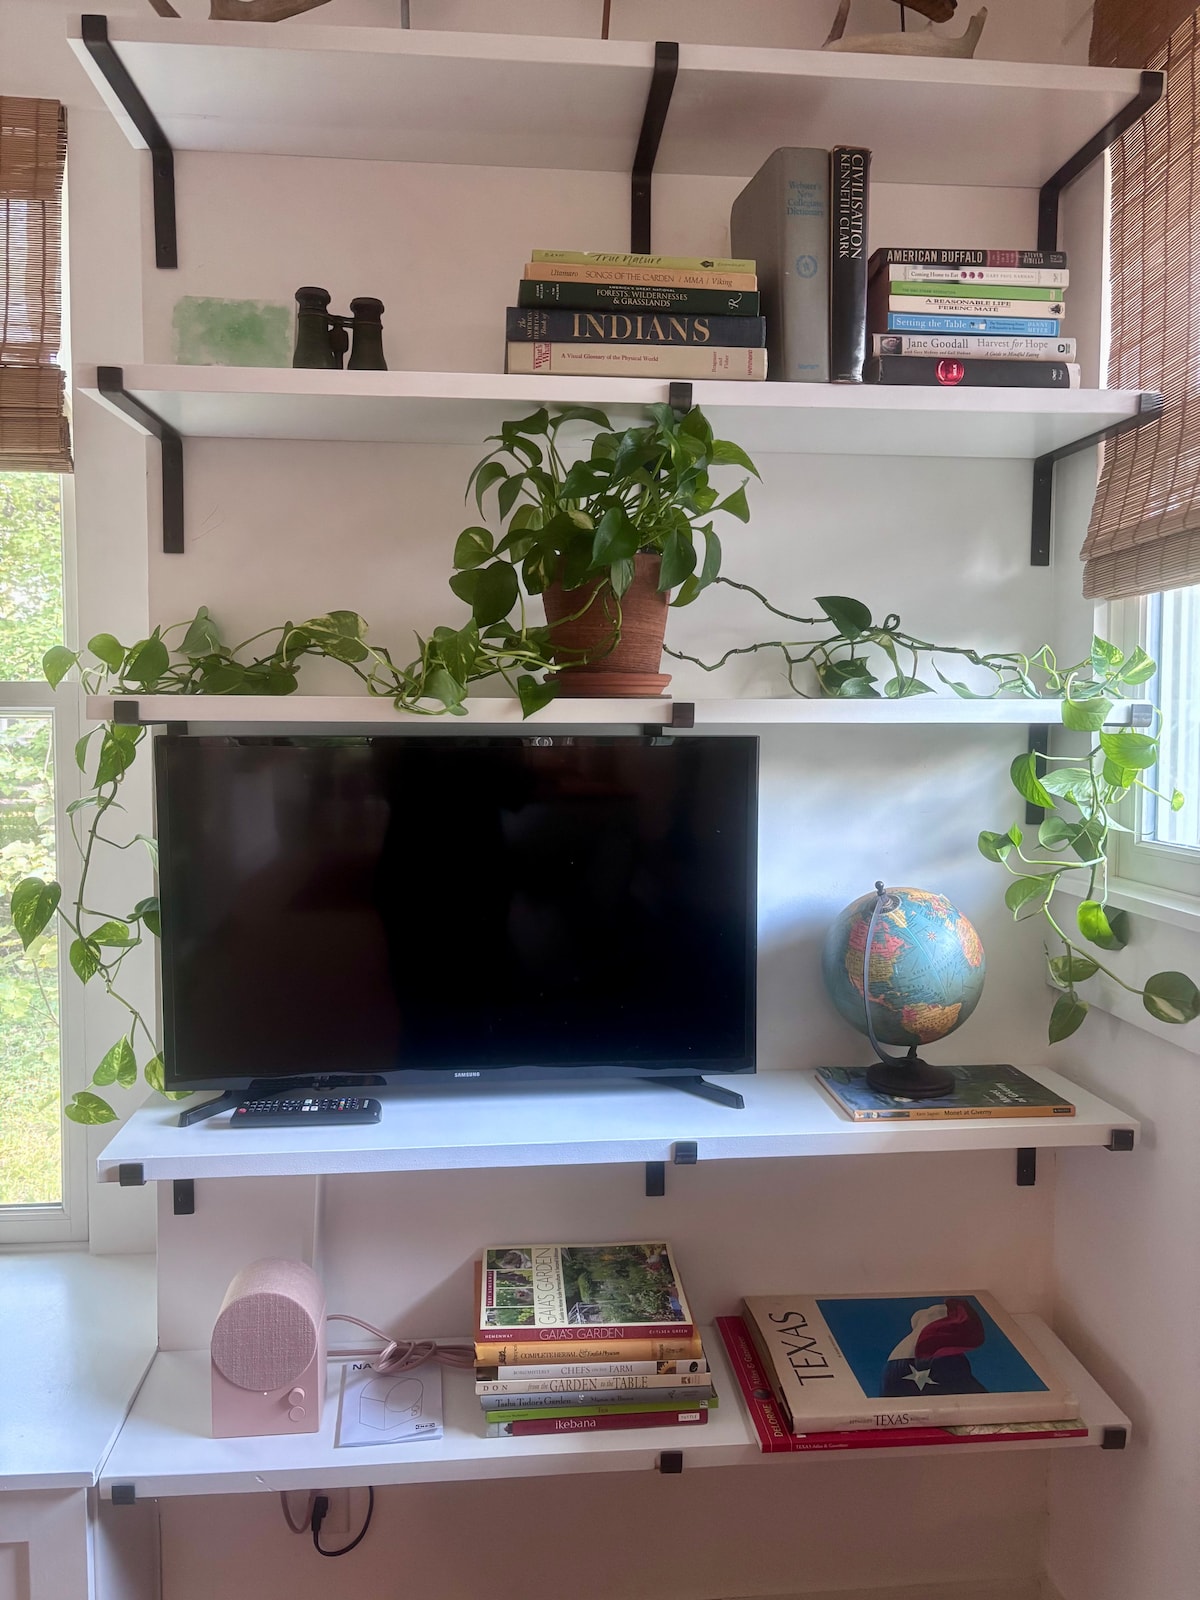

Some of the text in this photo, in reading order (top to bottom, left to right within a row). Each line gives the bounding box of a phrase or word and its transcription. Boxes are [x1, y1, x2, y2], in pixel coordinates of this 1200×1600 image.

[839, 154, 851, 259] KENNETH CLARK
[850, 153, 865, 260] CIVILISATION
[886, 250, 938, 263] AMERICAN
[941, 251, 983, 264] BUFFALO
[550, 269, 579, 277] Utamaro
[585, 270, 613, 279] SONGS
[614, 271, 625, 280] OF
[624, 272, 641, 281] THE
[643, 273, 675, 283] GARDEN
[712, 277, 733, 287] Viking
[631, 290, 688, 301] WILDERNESSES
[621, 298, 671, 308] GRASSLANDS
[571, 313, 711, 343] INDIANS
[895, 317, 967, 330] Setting the Table
[906, 337, 969, 350] Jane Goodall
[977, 337, 1049, 351] Harvest for Hope
[535, 343, 543, 369] What's
[542, 343, 551, 363] What
[583, 353, 606, 361] Glossary
[535, 1247, 557, 1325] GAIA'S GARDEN
[539, 1328, 574, 1341] GAIA'S
[576, 1327, 624, 1339] GARDEN
[520, 1351, 553, 1359] COMPLETE
[768, 1310, 834, 1387] TEXAS
[560, 1365, 591, 1375] CHEFS
[609, 1364, 633, 1373] FARM
[549, 1378, 597, 1392] GARDEN
[613, 1376, 648, 1390] TABLE
[543, 1396, 572, 1405] Garden
[554, 1419, 597, 1430] ikebana
[872, 1413, 909, 1427] TEXAS
